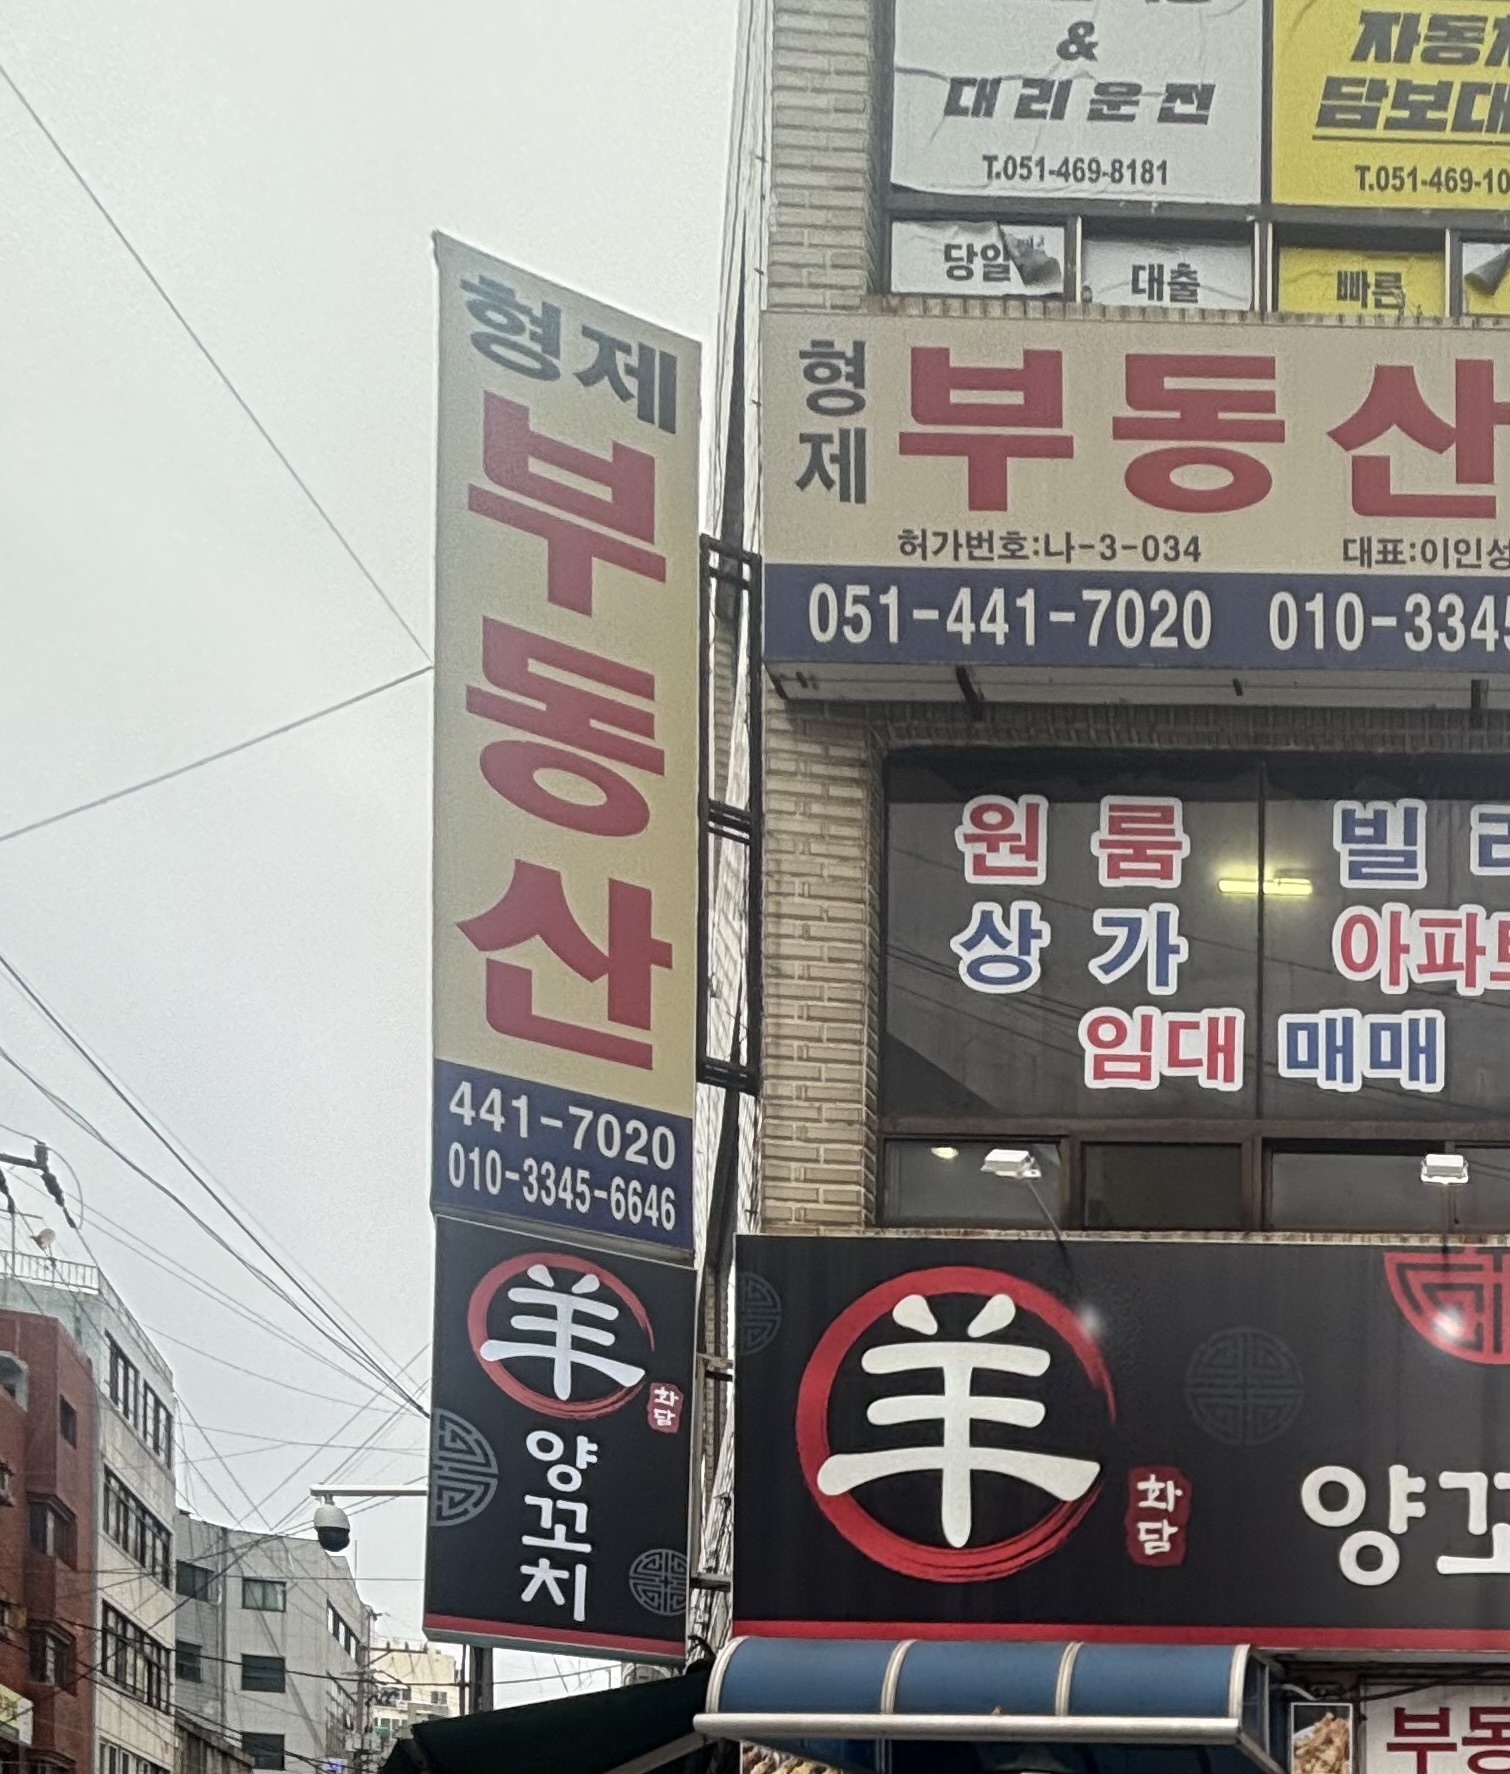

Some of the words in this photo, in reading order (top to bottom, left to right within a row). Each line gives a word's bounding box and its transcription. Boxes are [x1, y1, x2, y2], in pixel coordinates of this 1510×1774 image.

[1057, 20, 1098, 61] &
[983, 155, 1169, 188] T.051-469-8181
[1132, 261, 1201, 304] 대출
[1337, 269, 1405, 311] 빠른
[460, 274, 678, 435] 형제
[808, 582, 1213, 651] 051-441-7020
[454, 389, 673, 1071] 부동산
[1079, 1006, 1245, 1092] 임대
[1277, 1009, 1446, 1093] 매매
[449, 1080, 677, 1171] 441-7020
[448, 1141, 677, 1233] 010-3345-6646
[480, 1264, 647, 1401] 羊
[816, 1292, 1103, 1549] 羊
[519, 1430, 599, 1623] 양꼬치
[1136, 1474, 1182, 1559] 화담
